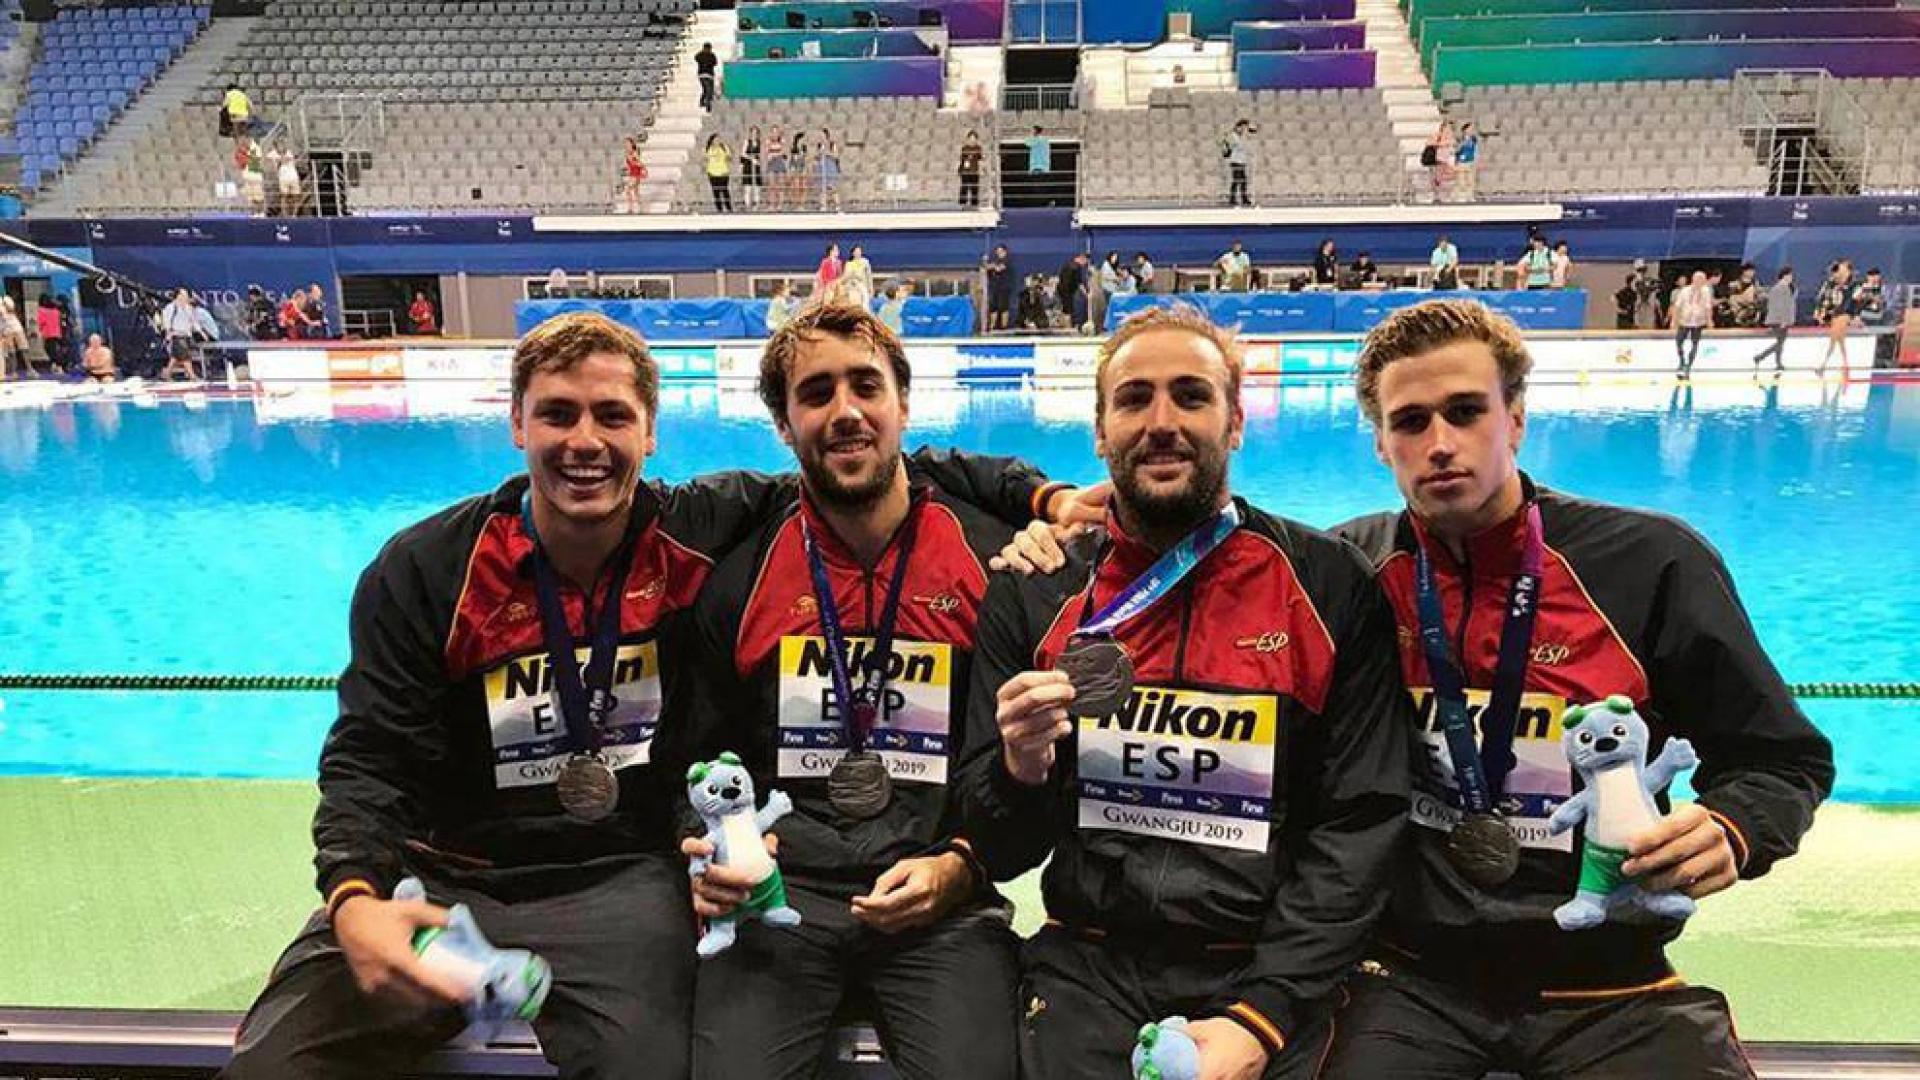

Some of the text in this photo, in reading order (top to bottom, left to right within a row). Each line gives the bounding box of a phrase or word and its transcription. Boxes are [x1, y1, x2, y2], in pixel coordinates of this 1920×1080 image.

[1256, 631, 1289, 652] ESP
[821, 687, 906, 722] EP
[1098, 690, 1257, 742] Nikon
[1122, 741, 1222, 784] ESP
[1203, 823, 1244, 841] 2019
